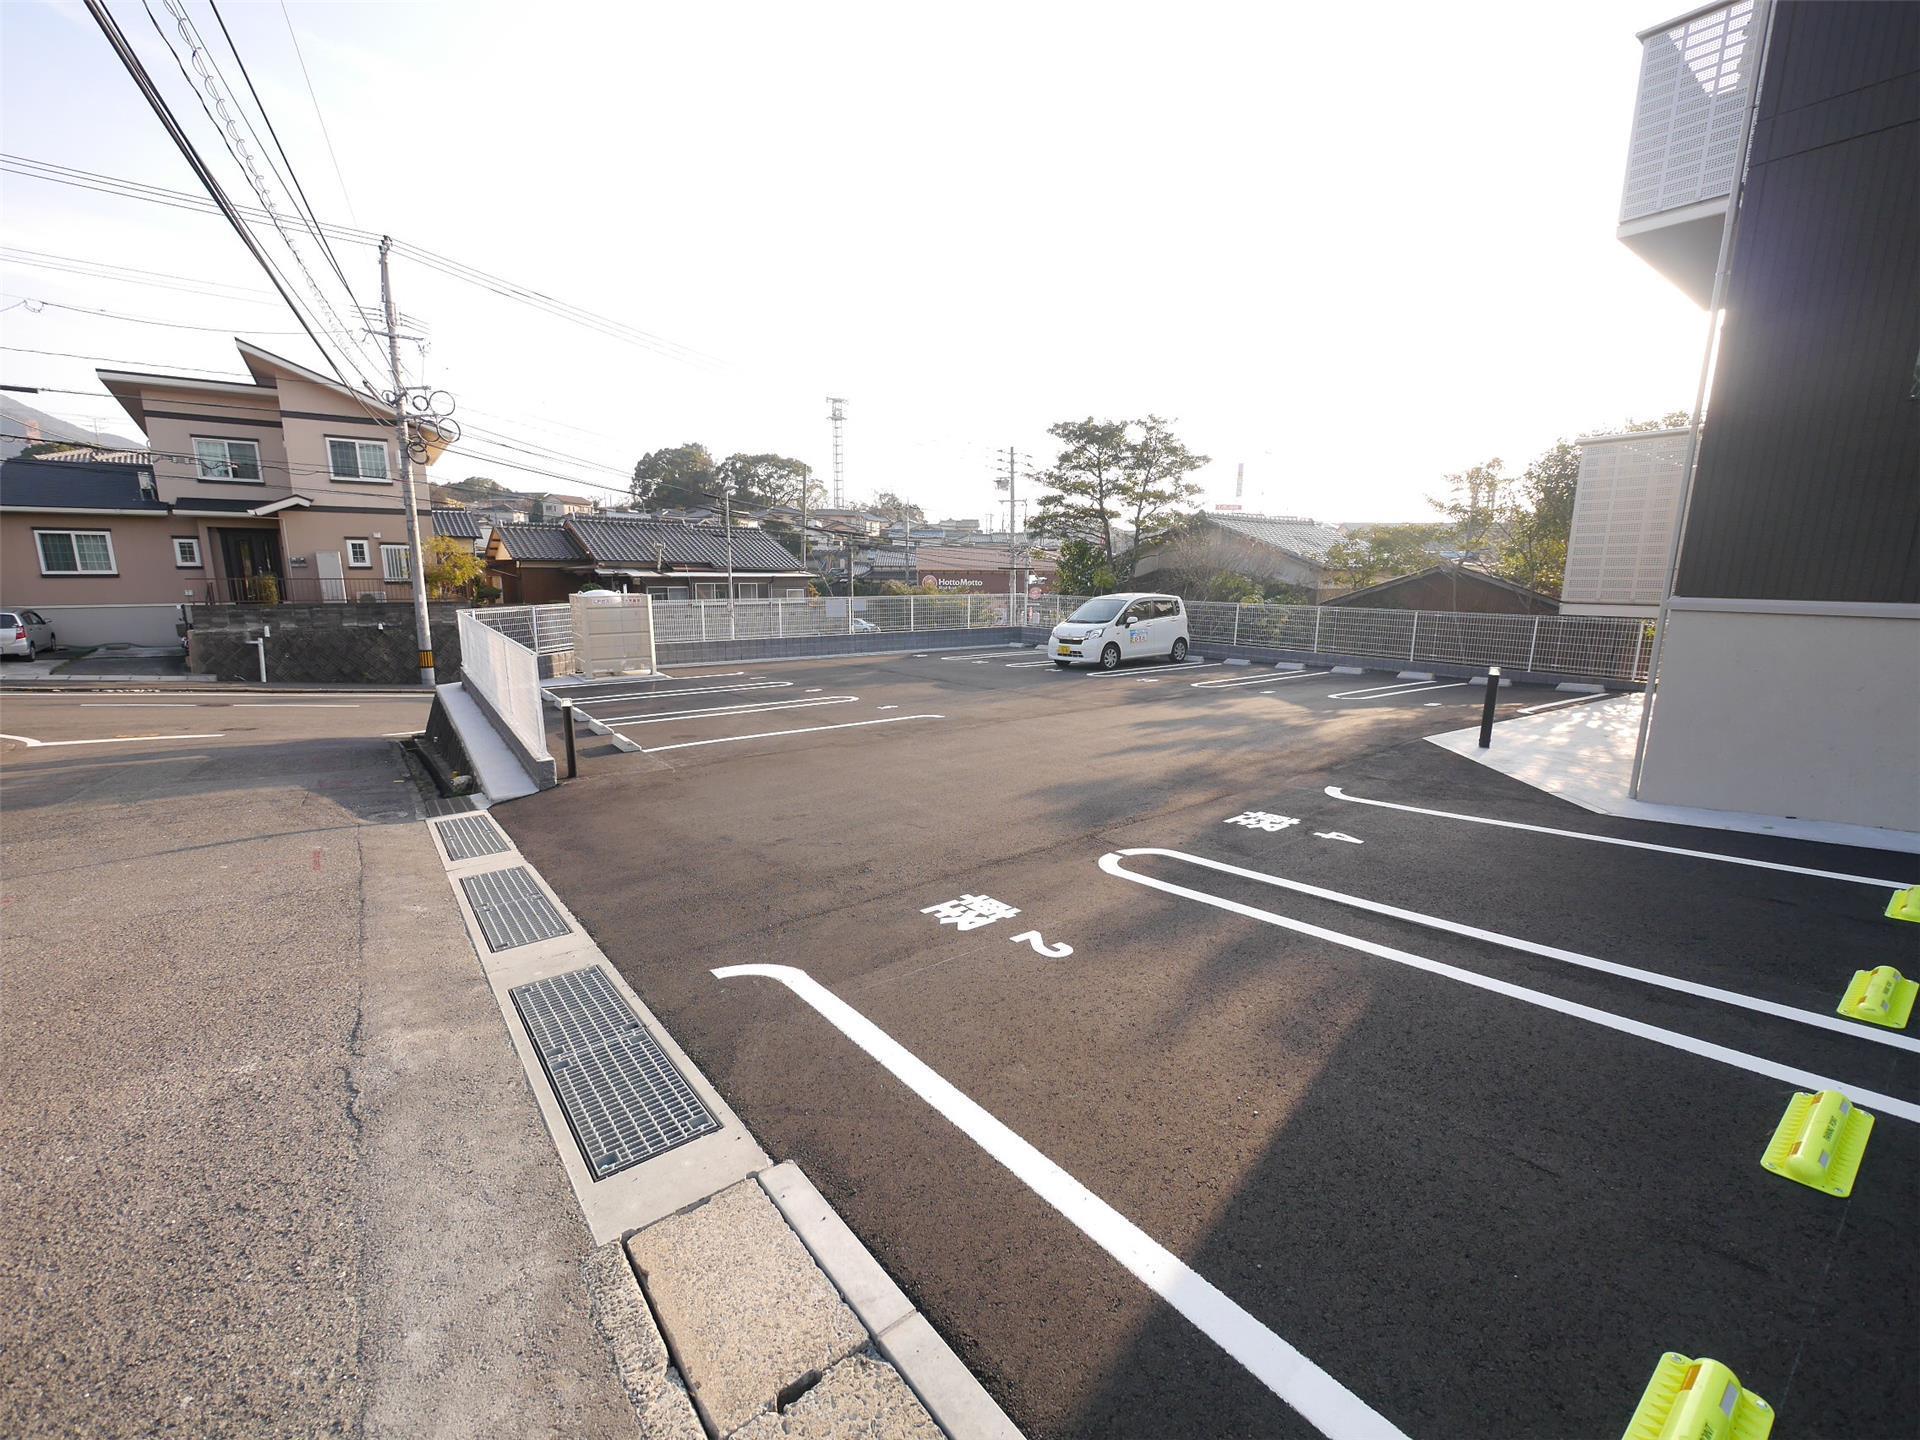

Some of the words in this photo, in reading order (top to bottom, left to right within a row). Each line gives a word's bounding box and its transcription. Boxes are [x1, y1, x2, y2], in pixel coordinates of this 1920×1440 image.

[1222, 811, 1301, 832] 軽
[1313, 831, 1365, 844] 4
[919, 893, 1022, 931] 軽
[1009, 930, 1074, 958] 2
